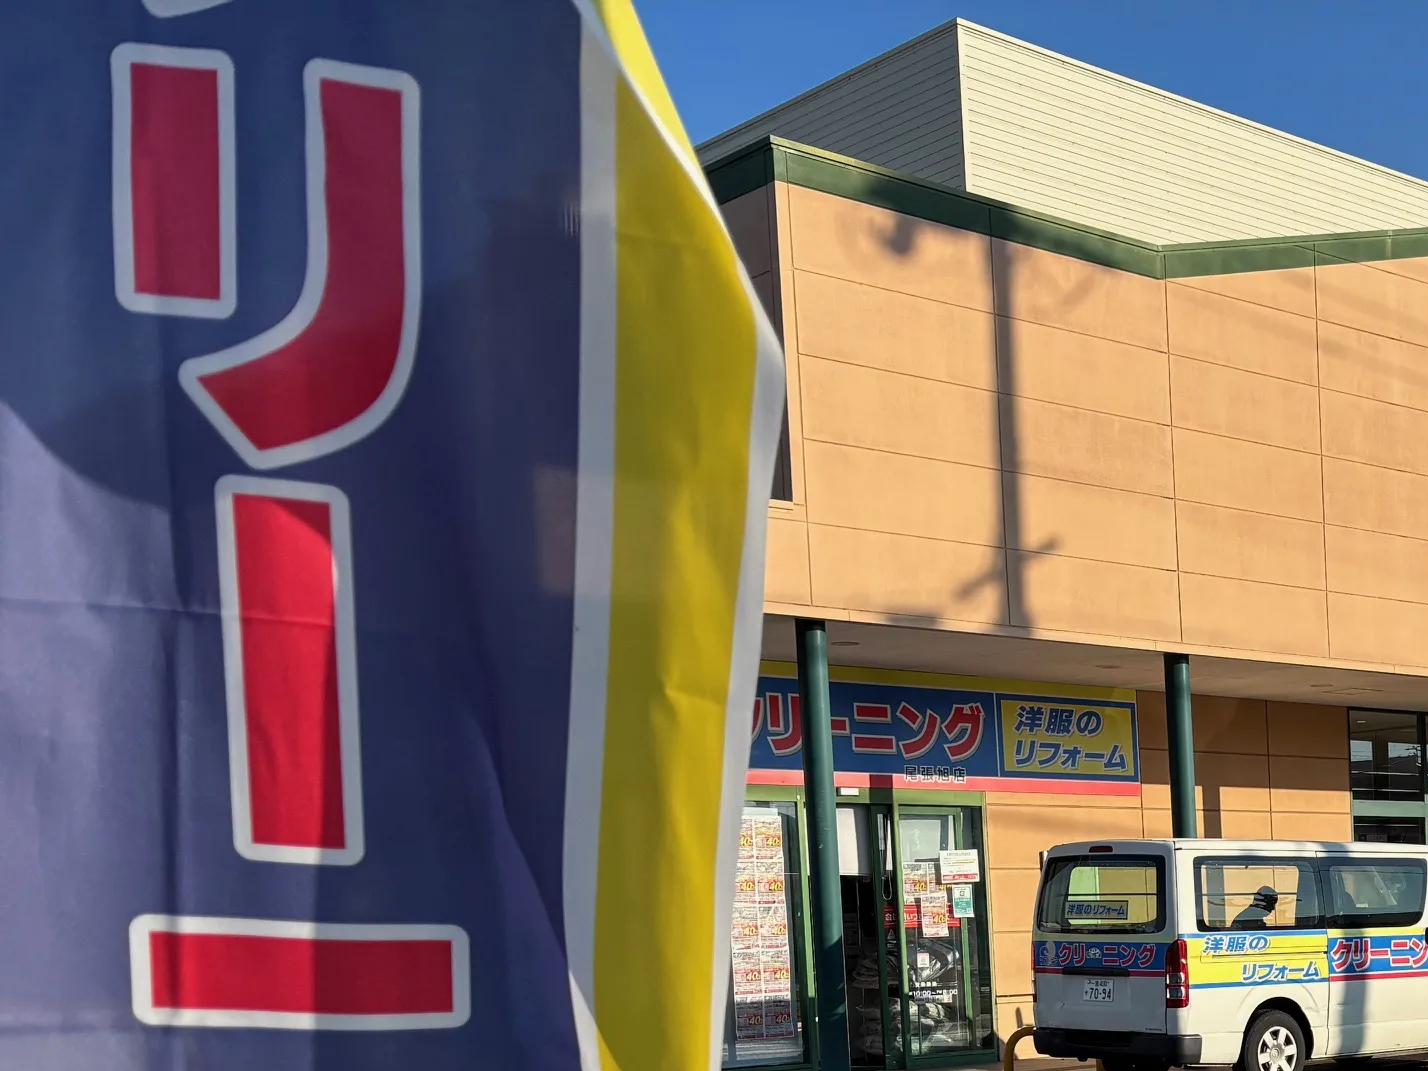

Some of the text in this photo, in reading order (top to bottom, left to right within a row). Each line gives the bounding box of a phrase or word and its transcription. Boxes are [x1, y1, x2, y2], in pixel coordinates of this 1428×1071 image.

[1013, 704, 1103, 736] 洋服の
[1013, 740, 1130, 772] リフォーム
[903, 765, 967, 783] 尾張旭店
[1066, 903, 1125, 916] 洋服のリフォーム
[1202, 934, 1271, 954] 洋服の
[1241, 960, 1321, 983] リフォーム
